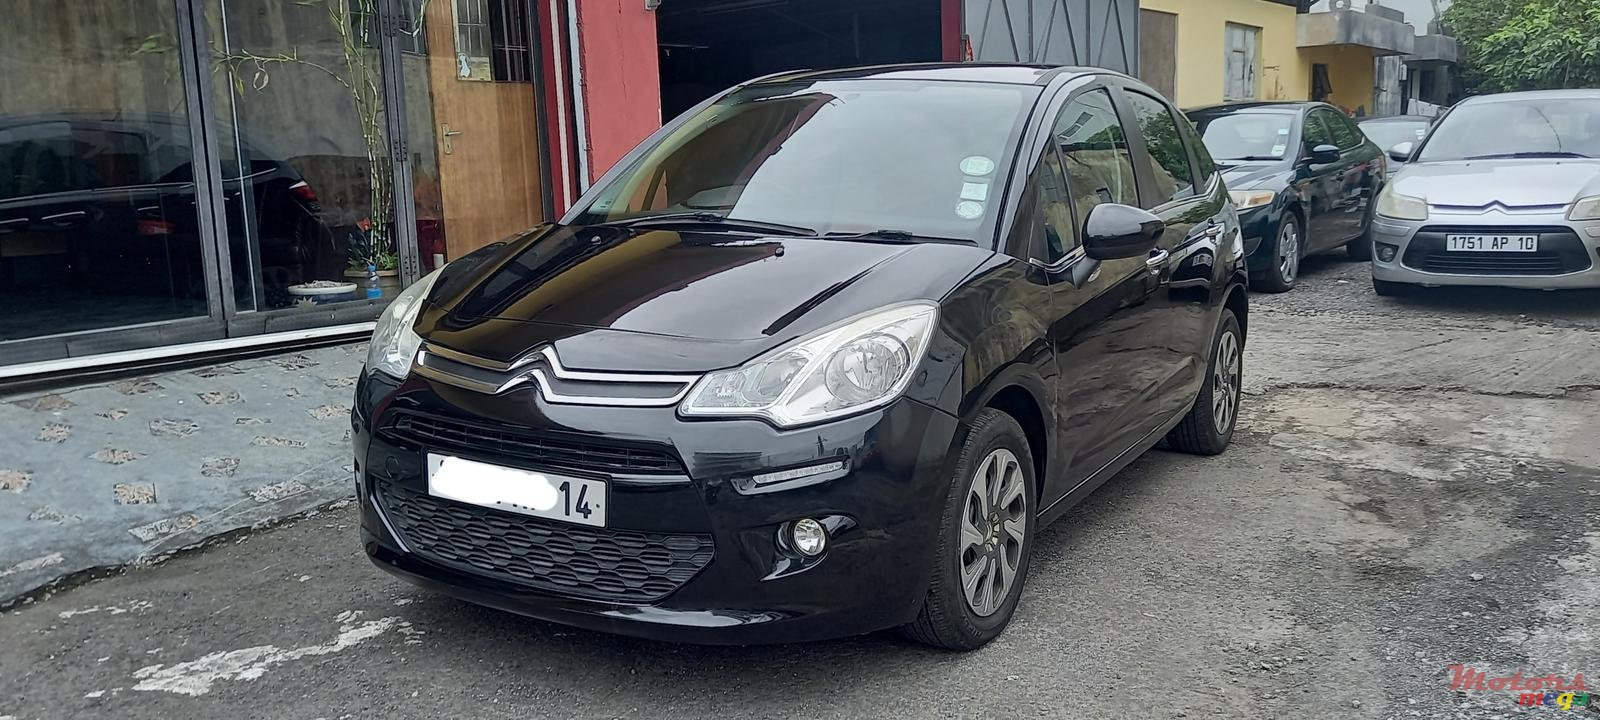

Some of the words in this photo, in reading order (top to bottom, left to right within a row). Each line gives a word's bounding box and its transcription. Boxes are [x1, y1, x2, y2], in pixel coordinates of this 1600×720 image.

[1451, 236, 1483, 249] 1751
[1491, 237, 1509, 250] AP
[1517, 237, 1534, 250] 10
[559, 481, 592, 519] 14
